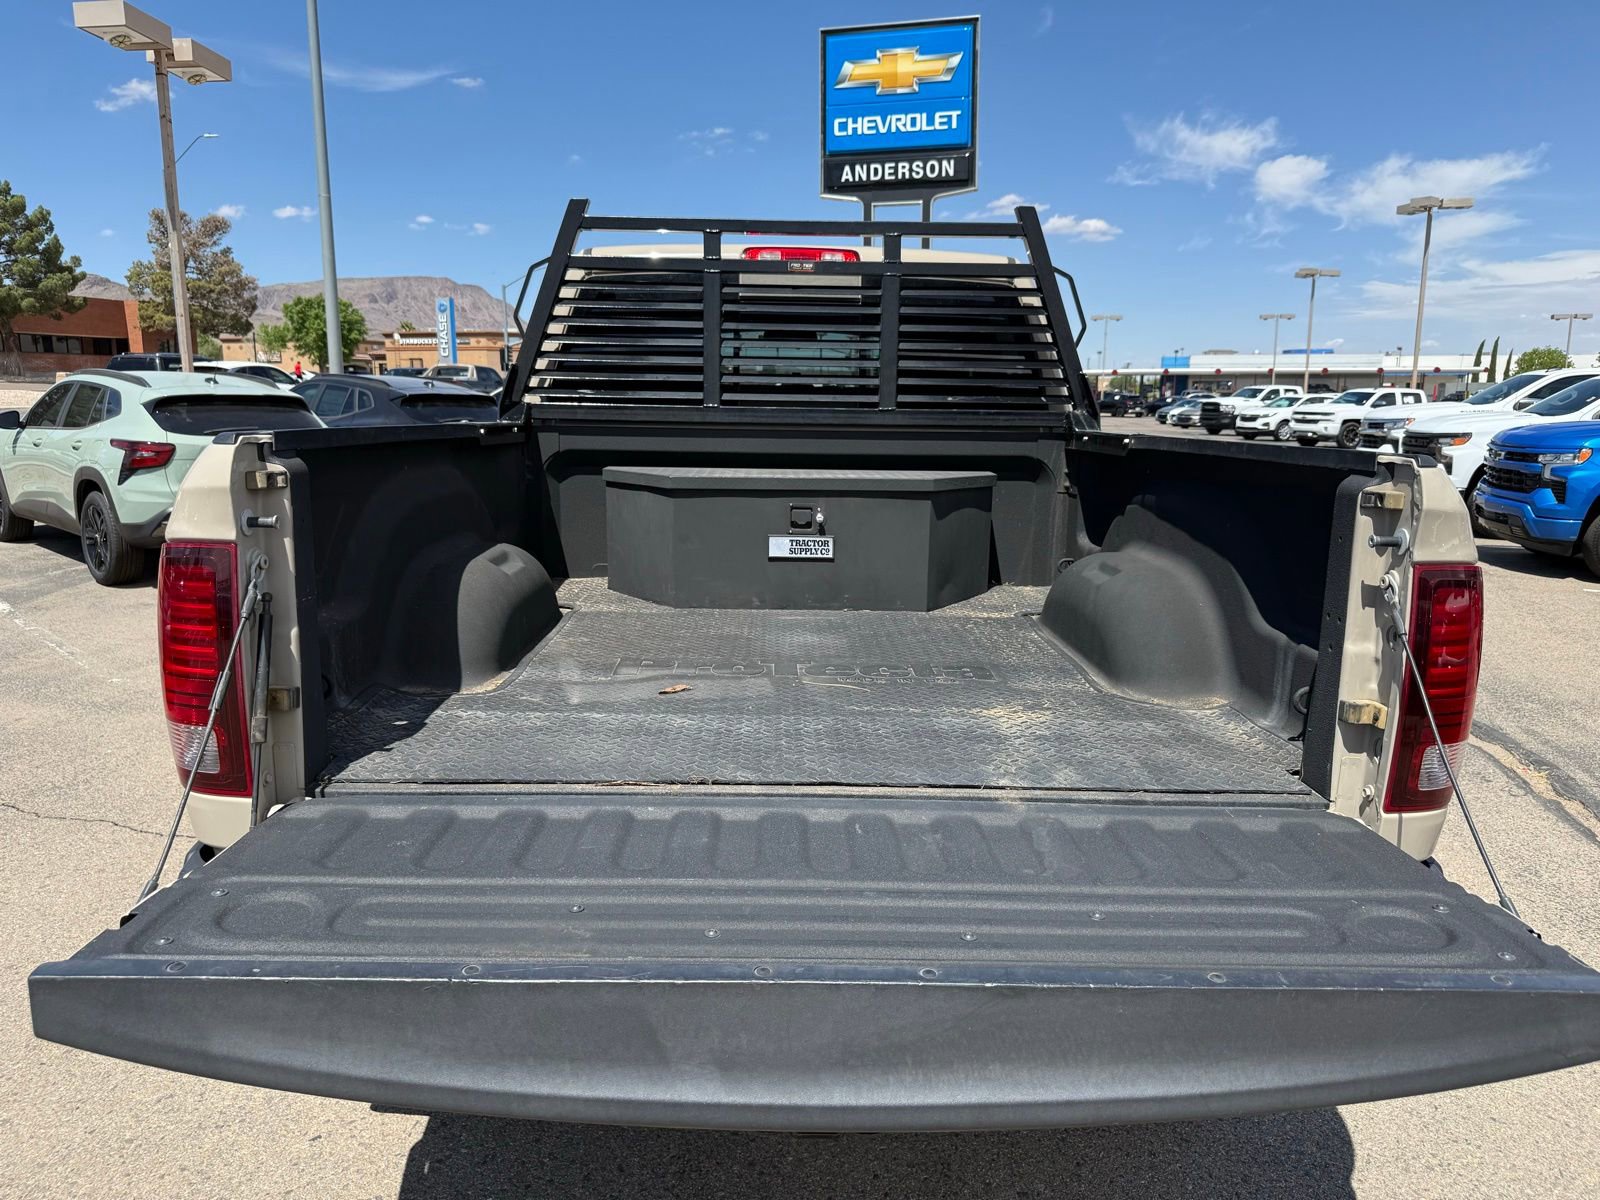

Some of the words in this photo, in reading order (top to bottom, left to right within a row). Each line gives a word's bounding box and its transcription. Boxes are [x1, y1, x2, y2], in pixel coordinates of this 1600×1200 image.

[833, 110, 962, 137] CHEVROLET
[840, 159, 955, 183] ANDERSON
[438, 314, 449, 357] CHASE
[788, 547, 819, 555] SUPPLY
[789, 539, 830, 548] TRACTOR
